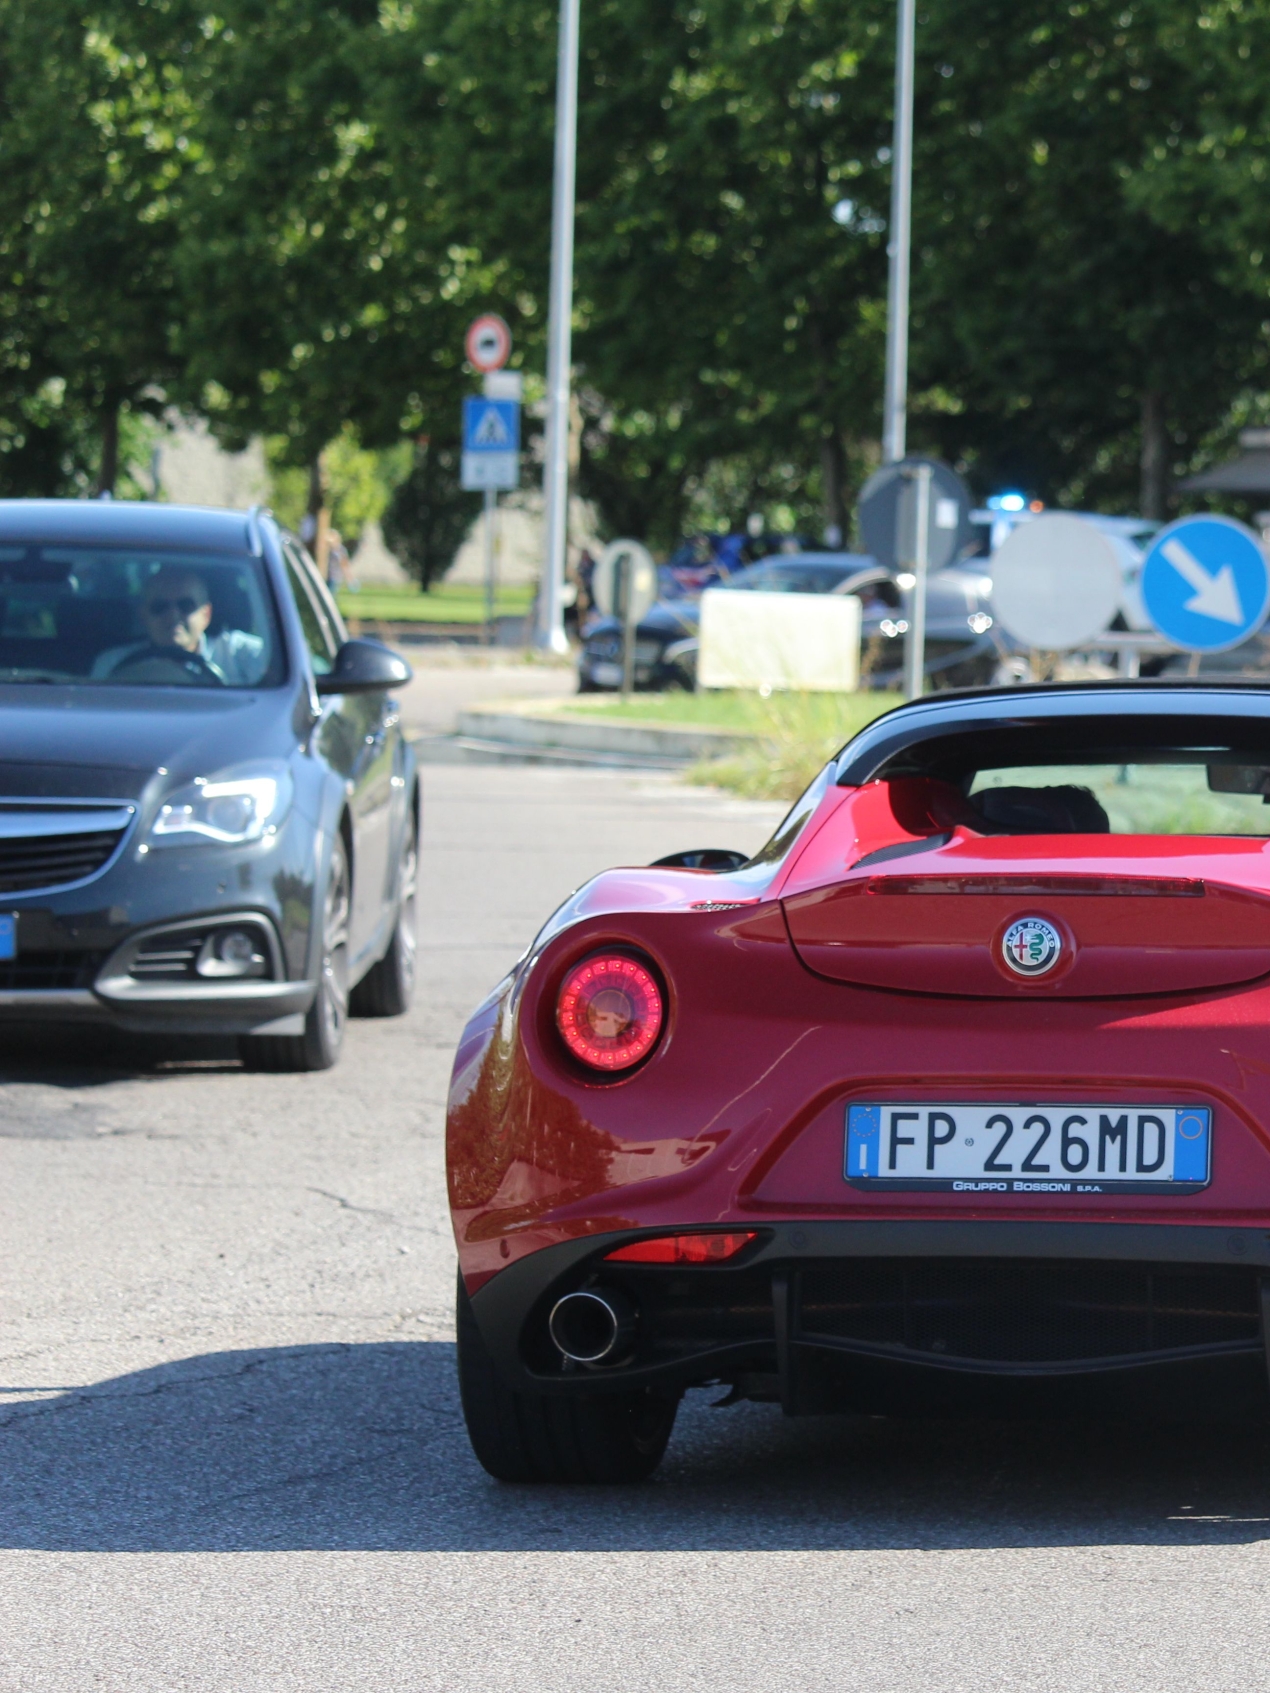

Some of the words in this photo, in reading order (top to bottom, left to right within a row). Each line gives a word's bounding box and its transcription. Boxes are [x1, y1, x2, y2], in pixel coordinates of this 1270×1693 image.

[1007, 925, 1024, 948] ALFA
[1027, 922, 1055, 948] ROMEO
[888, 1112, 956, 1170] FP
[983, 1114, 1166, 1173] 226MD
